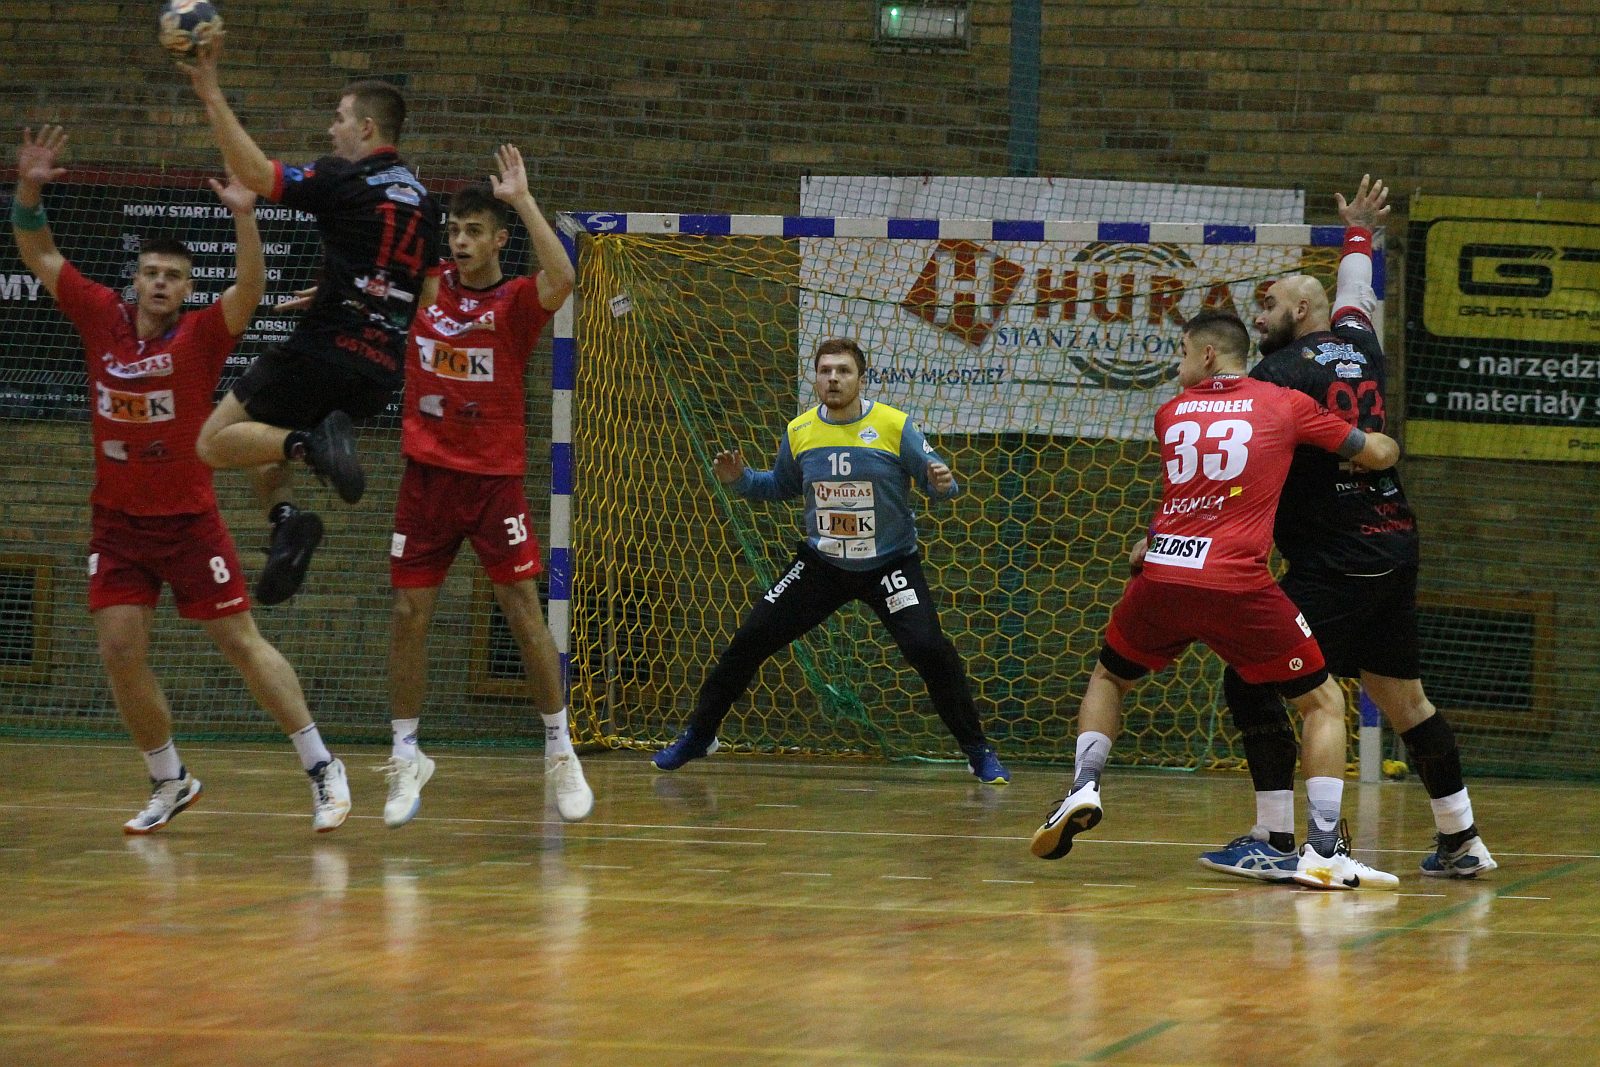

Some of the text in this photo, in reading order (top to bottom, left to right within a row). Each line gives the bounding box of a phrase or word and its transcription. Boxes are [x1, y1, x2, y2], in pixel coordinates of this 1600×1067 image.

[123, 204, 167, 218] NOWY
[169, 205, 211, 219] START
[213, 206, 233, 220] DL
[375, 202, 425, 277] 14
[998, 326, 1182, 355] STANZAUTOM
[1175, 399, 1253, 415] MOSIOŁEK
[1448, 390, 1586, 420] materiały
[827, 452, 852, 476] 16
[1164, 419, 1253, 485] 33
[834, 488, 871, 498] HURAS
[819, 515, 873, 533] LPGK
[209, 556, 231, 584] 8
[764, 560, 806, 604] Kempa
[880, 569, 908, 594] 16
